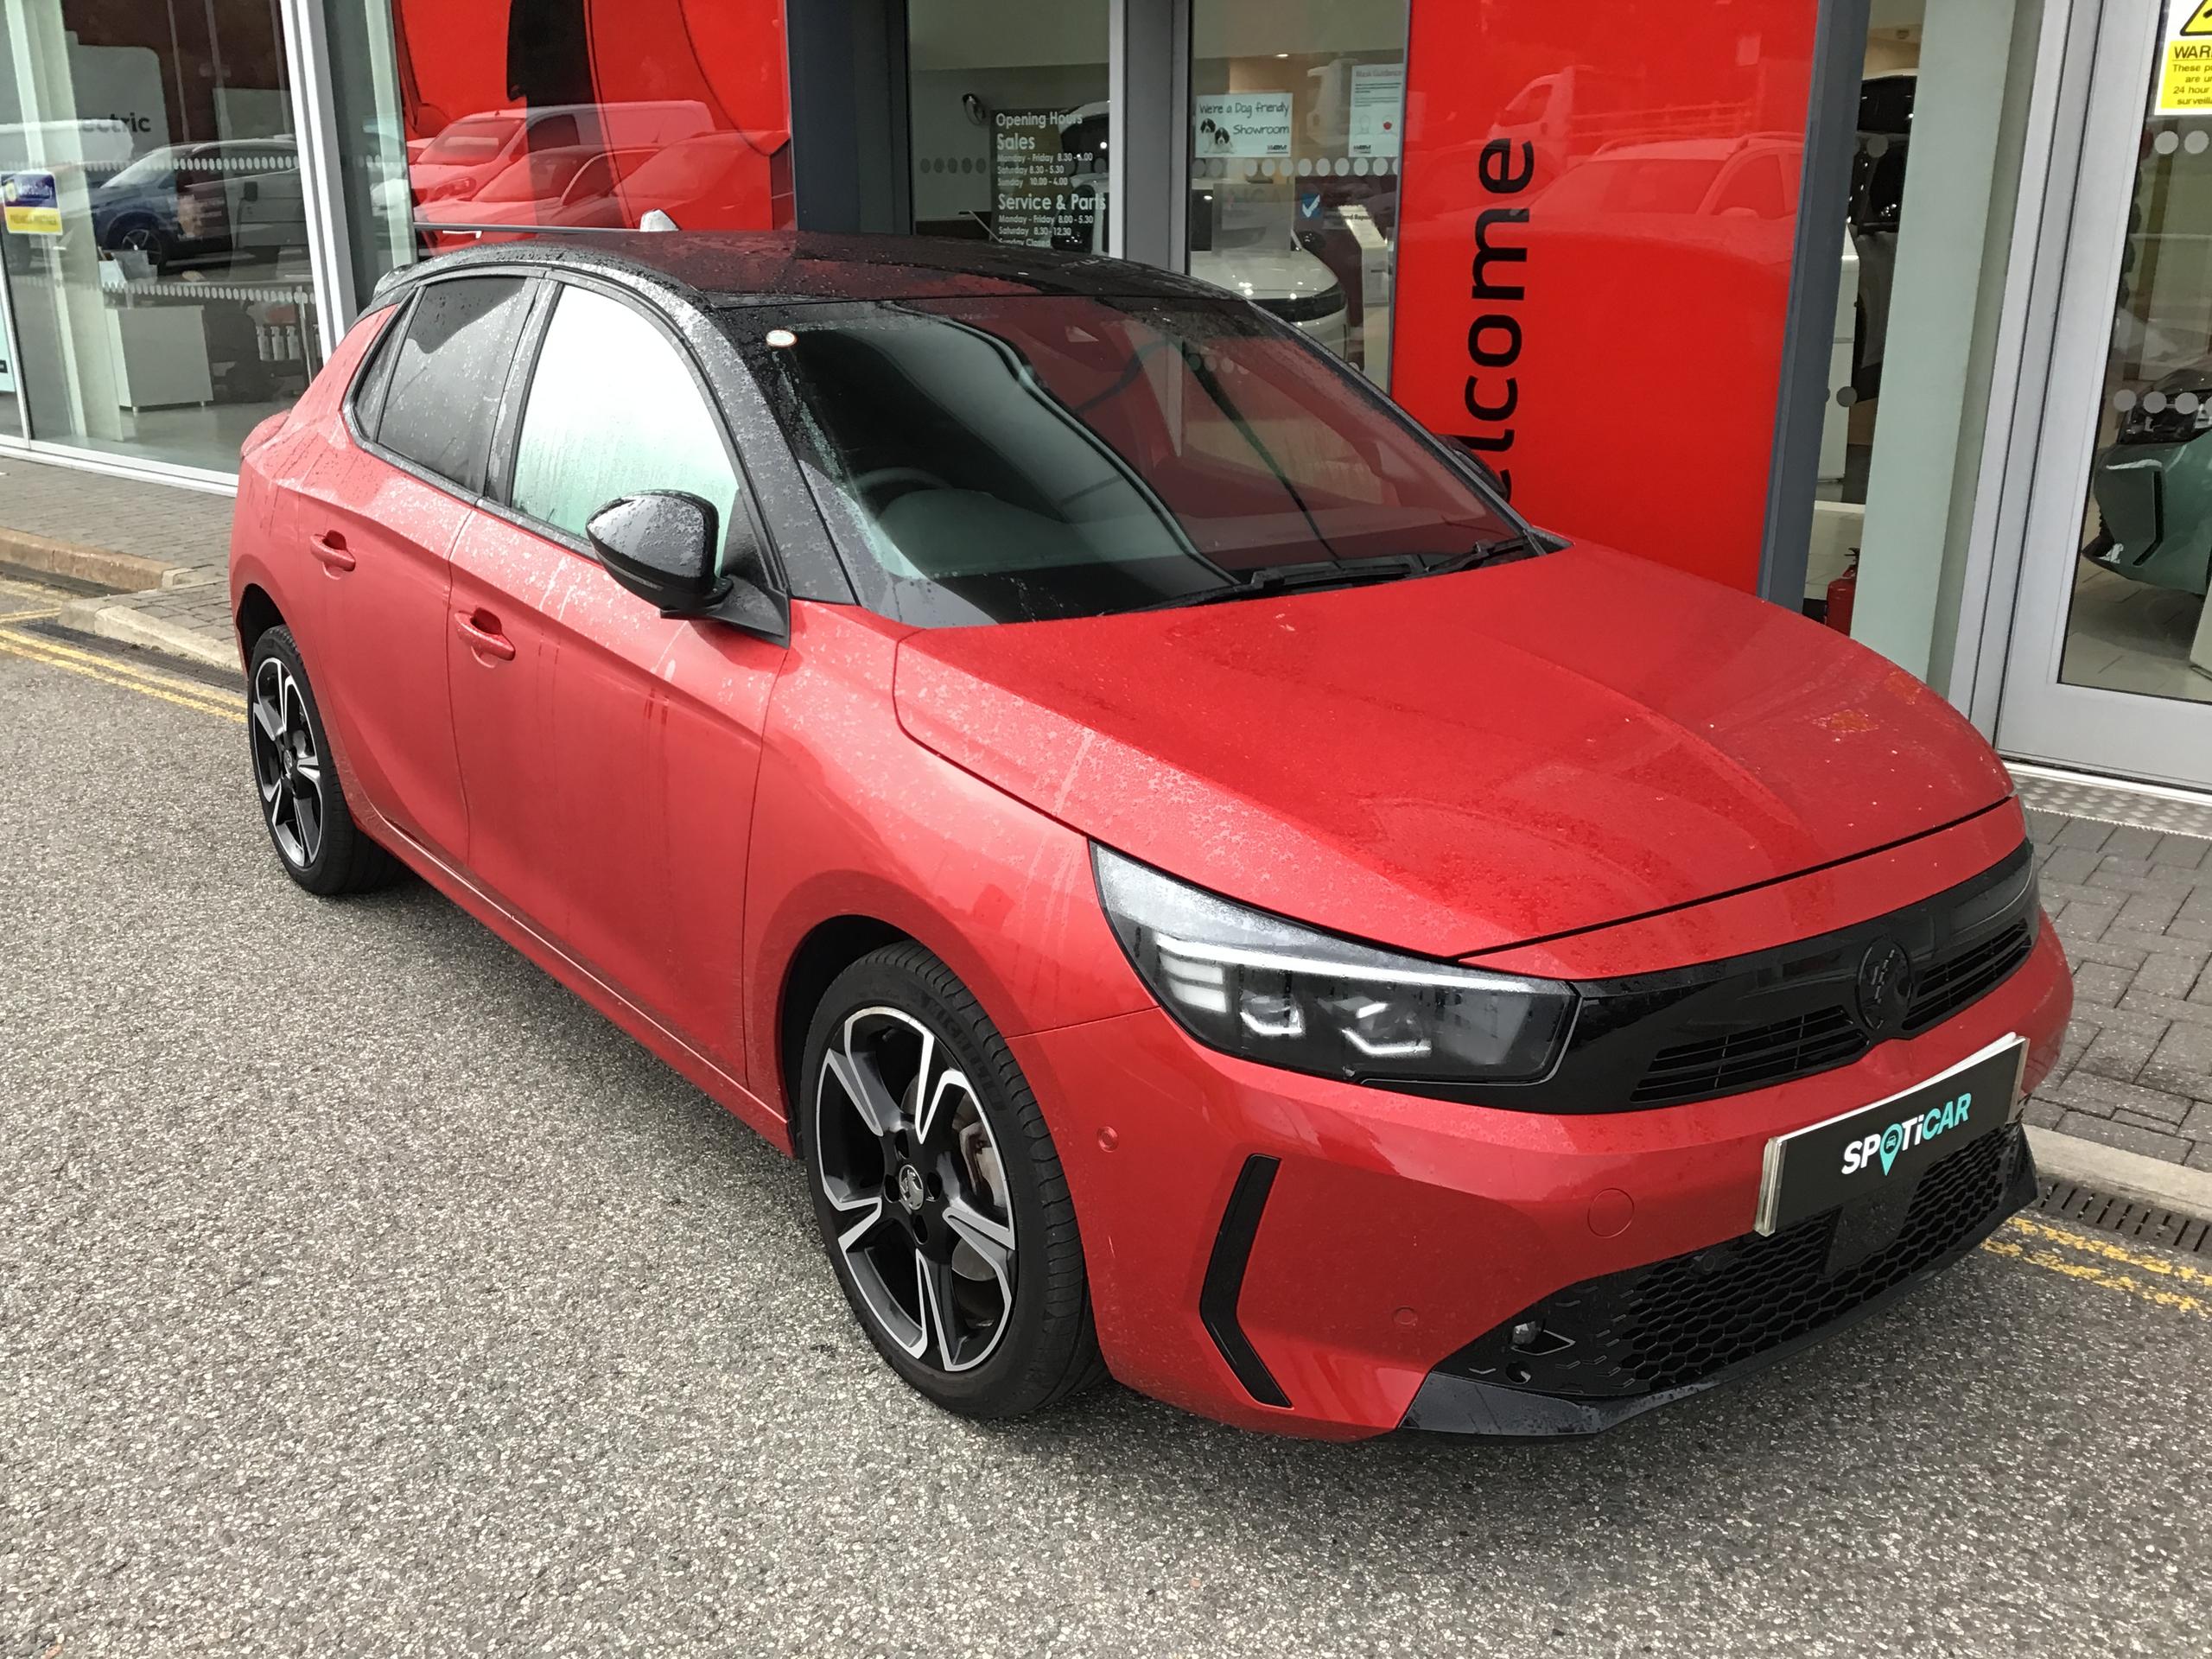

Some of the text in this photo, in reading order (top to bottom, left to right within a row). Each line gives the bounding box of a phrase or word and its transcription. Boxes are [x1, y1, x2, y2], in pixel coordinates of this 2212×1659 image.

[2174, 45, 2212, 59] WAR
[1235, 102, 1252, 118] Dog
[1255, 101, 1289, 117] friendly
[995, 111, 1083, 129] Opening Hours
[1232, 124, 1289, 134] Showroom
[996, 133, 1035, 150] Sales
[996, 154, 1026, 164] Monday
[1032, 153, 1054, 163] Friday
[996, 165, 1028, 175] Saturday
[1029, 165, 1045, 174] 8.30
[1049, 165, 1065, 174] 5.30
[997, 177, 1024, 188] Sunday
[1029, 177, 1048, 186] 10.00
[1052, 177, 1068, 186] 4.00
[998, 193, 1106, 211] Service & Parts
[998, 215, 1027, 225] Monday
[1033, 215, 1055, 225] Friday
[1058, 215, 1073, 224] 8.00
[1078, 215, 1093, 224] 5.30
[998, 226, 1029, 237] Saturday
[1033, 226, 1048, 235] 8.30
[1026, 238, 1052, 248] Closed
[1448, 137, 1535, 503] lcome
